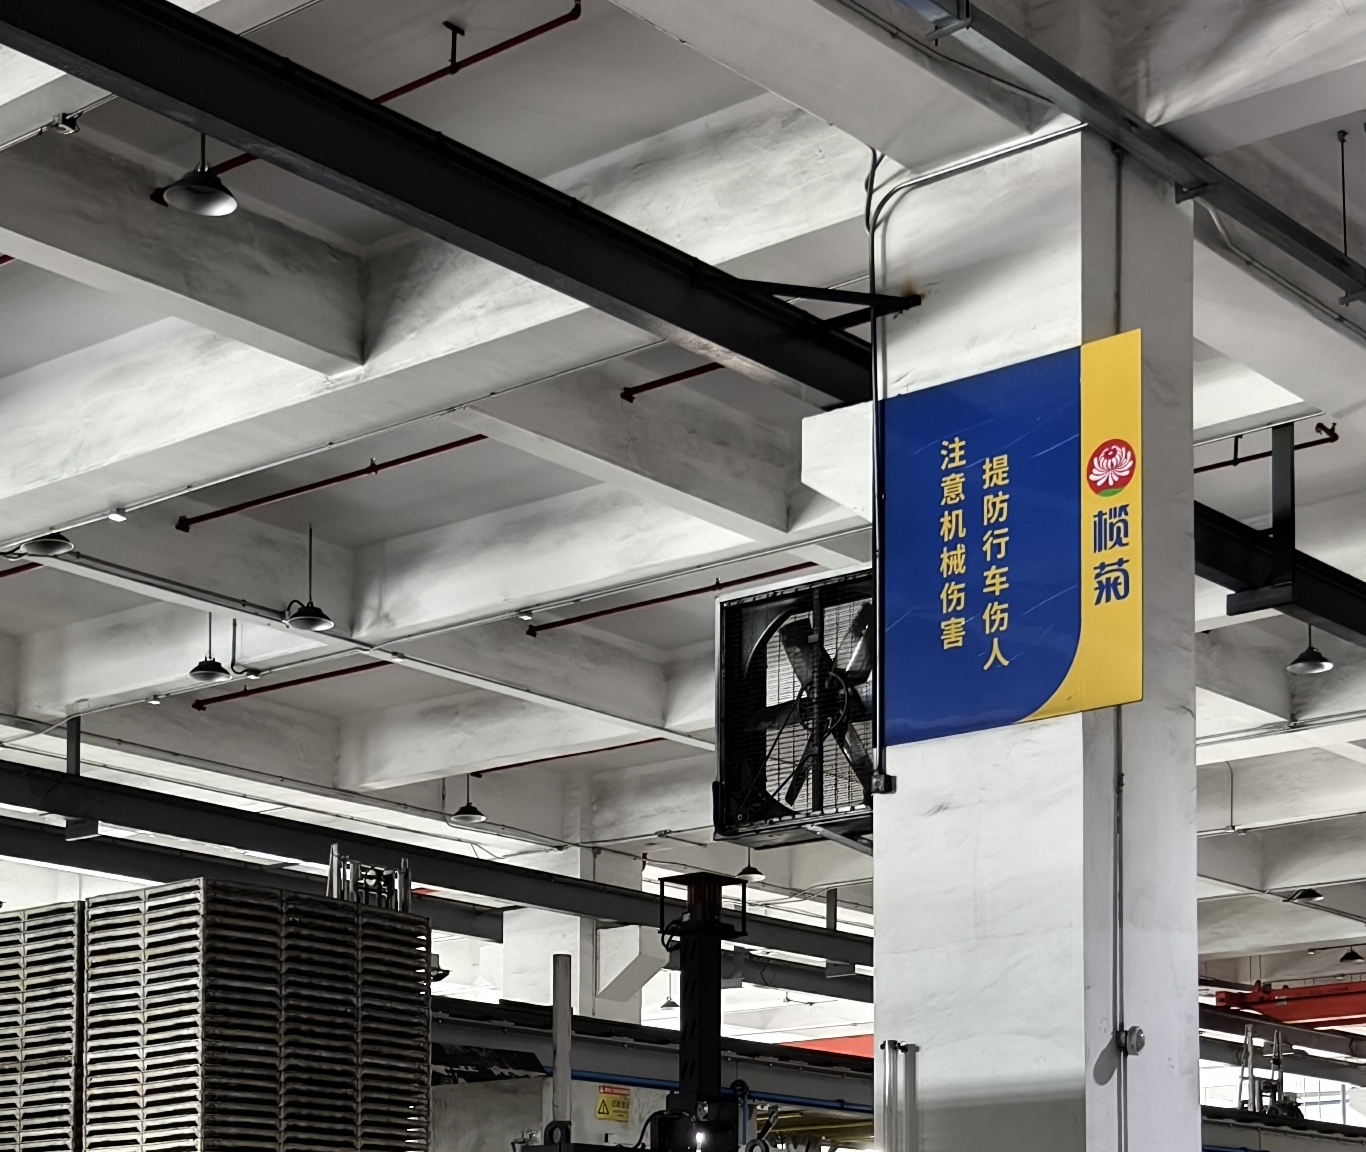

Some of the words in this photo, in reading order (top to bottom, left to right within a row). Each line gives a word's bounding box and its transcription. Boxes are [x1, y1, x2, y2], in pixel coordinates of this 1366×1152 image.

[939, 436, 967, 650] 注意机械伤害
[981, 453, 1010, 671] 提防行车伤人
[1092, 503, 1131, 606] 榄菊
